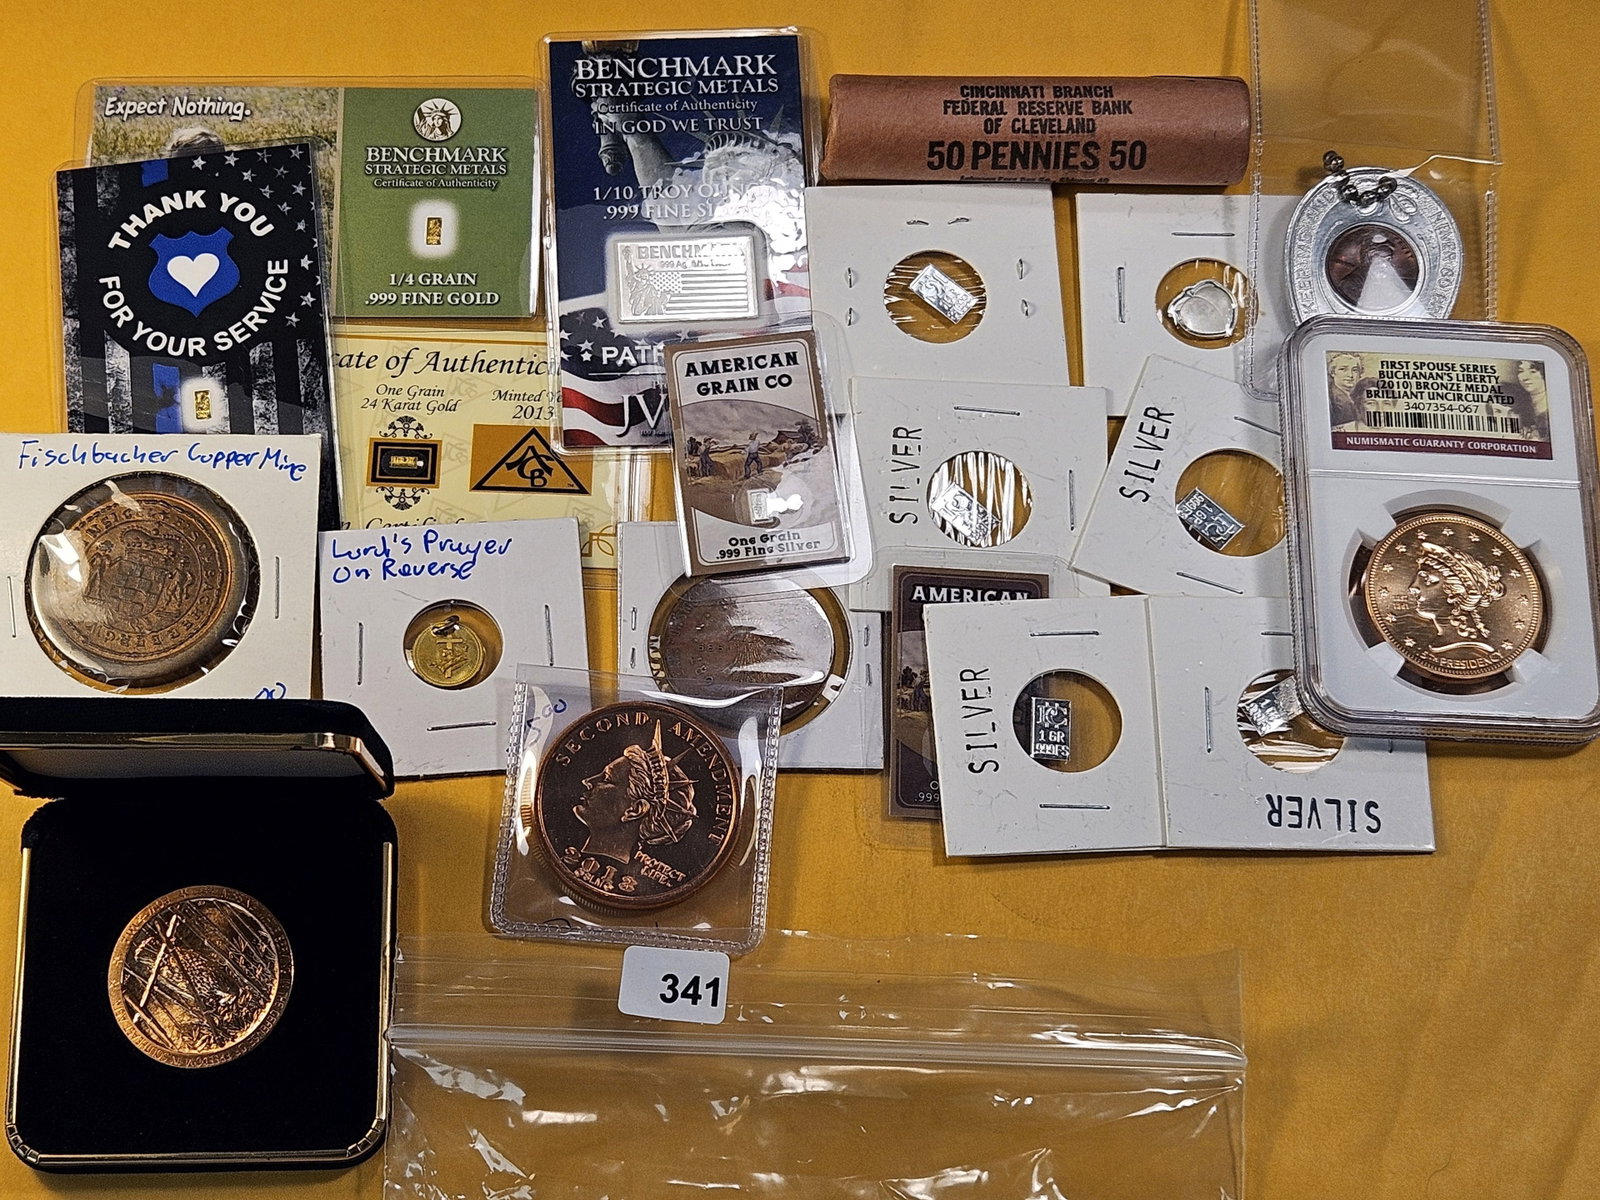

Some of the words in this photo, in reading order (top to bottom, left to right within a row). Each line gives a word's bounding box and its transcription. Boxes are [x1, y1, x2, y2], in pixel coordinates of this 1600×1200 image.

[574, 54, 777, 80] BENCHMARK
[575, 81, 692, 98] STRATEGIC
[698, 78, 779, 94] METALS
[960, 85, 1045, 99] CINCINNATI
[1053, 85, 1113, 99] BRANCH
[104, 97, 167, 120] Expect
[171, 97, 251, 121] Nothing.
[598, 101, 662, 113] Certificate
[666, 99, 679, 111] of
[681, 99, 758, 112] Authenticity
[943, 100, 1008, 116] FEDERAL
[1018, 100, 1084, 116] RESERVE
[1092, 99, 1133, 115] BANK
[594, 121, 617, 134] IN
[622, 120, 666, 133] GOD
[672, 119, 700, 132] WE
[704, 117, 763, 131] TRUST
[983, 117, 1002, 134] OF
[1011, 117, 1096, 135] CLEVELAND
[366, 147, 508, 162] BENCHMARK
[927, 140, 965, 171] 50
[971, 140, 1100, 171] PENNIES
[1109, 140, 1147, 171] 50
[365, 164, 446, 175] STRATEGIC
[450, 164, 507, 175] METALS
[374, 179, 424, 188] Certificate
[426, 178, 439, 188] of
[439, 179, 498, 189] Authenticity
[593, 186, 634, 200] 1/10
[638, 185, 693, 199] TROY
[697, 184, 758, 199] OUN
[108, 189, 206, 250] THANK
[220, 192, 274, 237] YOU
[603, 206, 638, 220] .999
[644, 204, 691, 218] FINE
[389, 273, 414, 286] 1/4
[418, 273, 477, 285] GRAIN
[365, 293, 397, 305] .999
[401, 293, 443, 305] FINE
[447, 292, 500, 305] GOLD
[99, 276, 135, 328] FOR
[131, 321, 206, 357] YOUR
[213, 259, 288, 351] SERVICE
[385, 347, 419, 378] of
[414, 348, 560, 377] Authentic
[685, 351, 799, 377] AMERICAN
[1380, 361, 1411, 371] FIRST
[1412, 361, 1458, 372] SPOUSE
[1460, 363, 1496, 374] SERIES
[697, 374, 761, 396] GRAIN
[765, 373, 793, 389] CO
[1378, 371, 1453, 382] BUCHANAN'S
[1455, 373, 1499, 384] LIBERTY
[375, 384, 403, 396] One
[406, 386, 445, 398] Grain
[491, 389, 548, 402] Minted
[1376, 380, 1413, 391] (2010)
[1415, 382, 1461, 392] BRONZE
[1464, 384, 1503, 394] MEDAL
[1366, 390, 1427, 400] BRILLIANT
[1428, 391, 1515, 405] UNCIRCULATED
[361, 398, 377, 410] 24
[382, 398, 421, 411] Karat
[426, 399, 462, 415] Gold
[512, 404, 554, 420] 2013
[1404, 401, 1479, 414] 3407354-067
[1346, 437, 1411, 448] NUMISMATIC
[1412, 438, 1465, 450] GUARANTY
[1467, 441, 1536, 454] CORPORATION
[187, 442, 260, 470] Copper
[1119, 406, 1175, 503] SILVER
[888, 426, 923, 524] SILVER
[333, 532, 412, 560] Lord's
[423, 528, 512, 566] Prayer
[728, 535, 756, 547] One
[760, 530, 801, 543] Grain
[716, 548, 741, 560] .999
[745, 546, 774, 557] Fine
[778, 540, 822, 554] Silver
[333, 567, 372, 583] On
[382, 558, 476, 580] Reverse
[912, 586, 1030, 602] AMERICAN
[960, 668, 999, 773] SILVER
[1050, 730, 1065, 742] GR
[556, 712, 650, 767] SECOND
[668, 721, 732, 842] AMENDMENT
[914, 792, 939, 803] .999
[1265, 793, 1382, 833] SILVER
[634, 850, 686, 881] PROTECT
[660, 974, 720, 1007] 341
